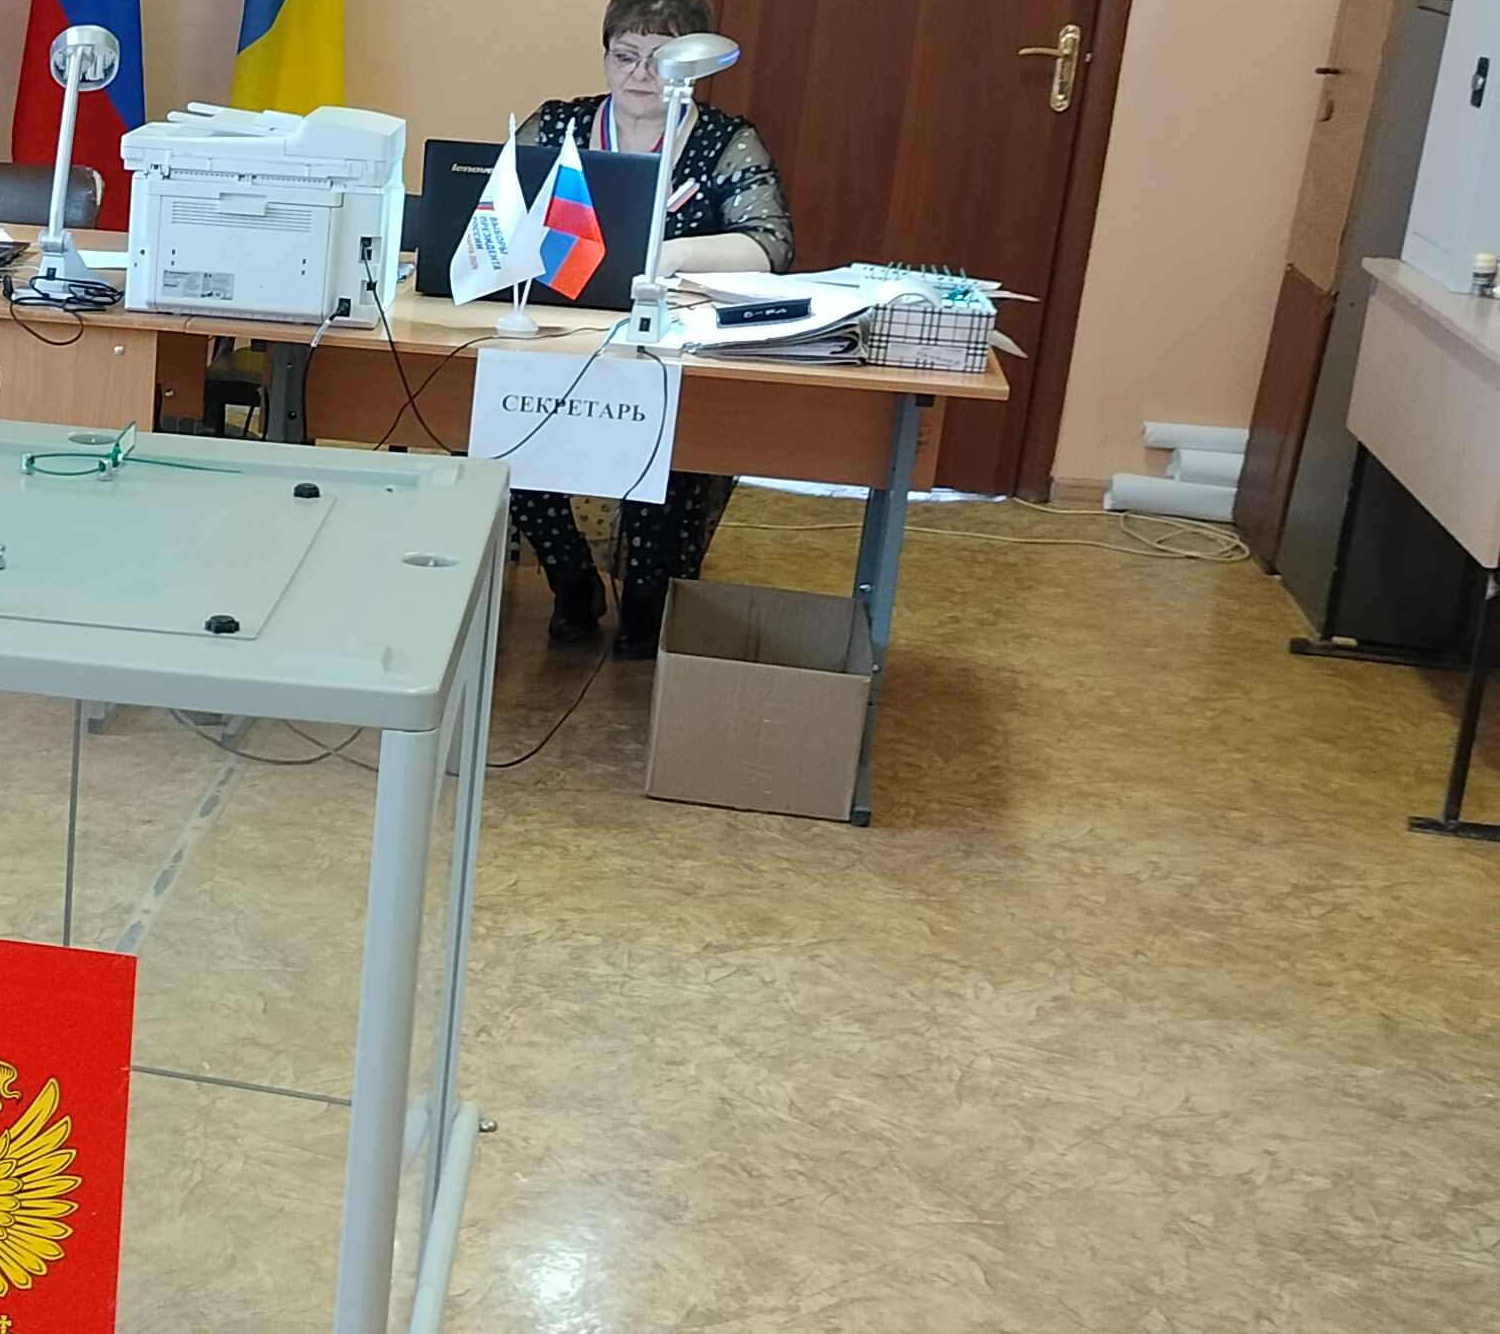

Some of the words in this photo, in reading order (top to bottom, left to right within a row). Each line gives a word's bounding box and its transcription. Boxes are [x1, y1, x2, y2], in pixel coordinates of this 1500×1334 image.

[479, 216, 502, 271] ПРЕЗИДЕНТА
[489, 216, 509, 255] ВЫБОРЫ
[502, 394, 646, 422] СЕКРЕТАРЬ
